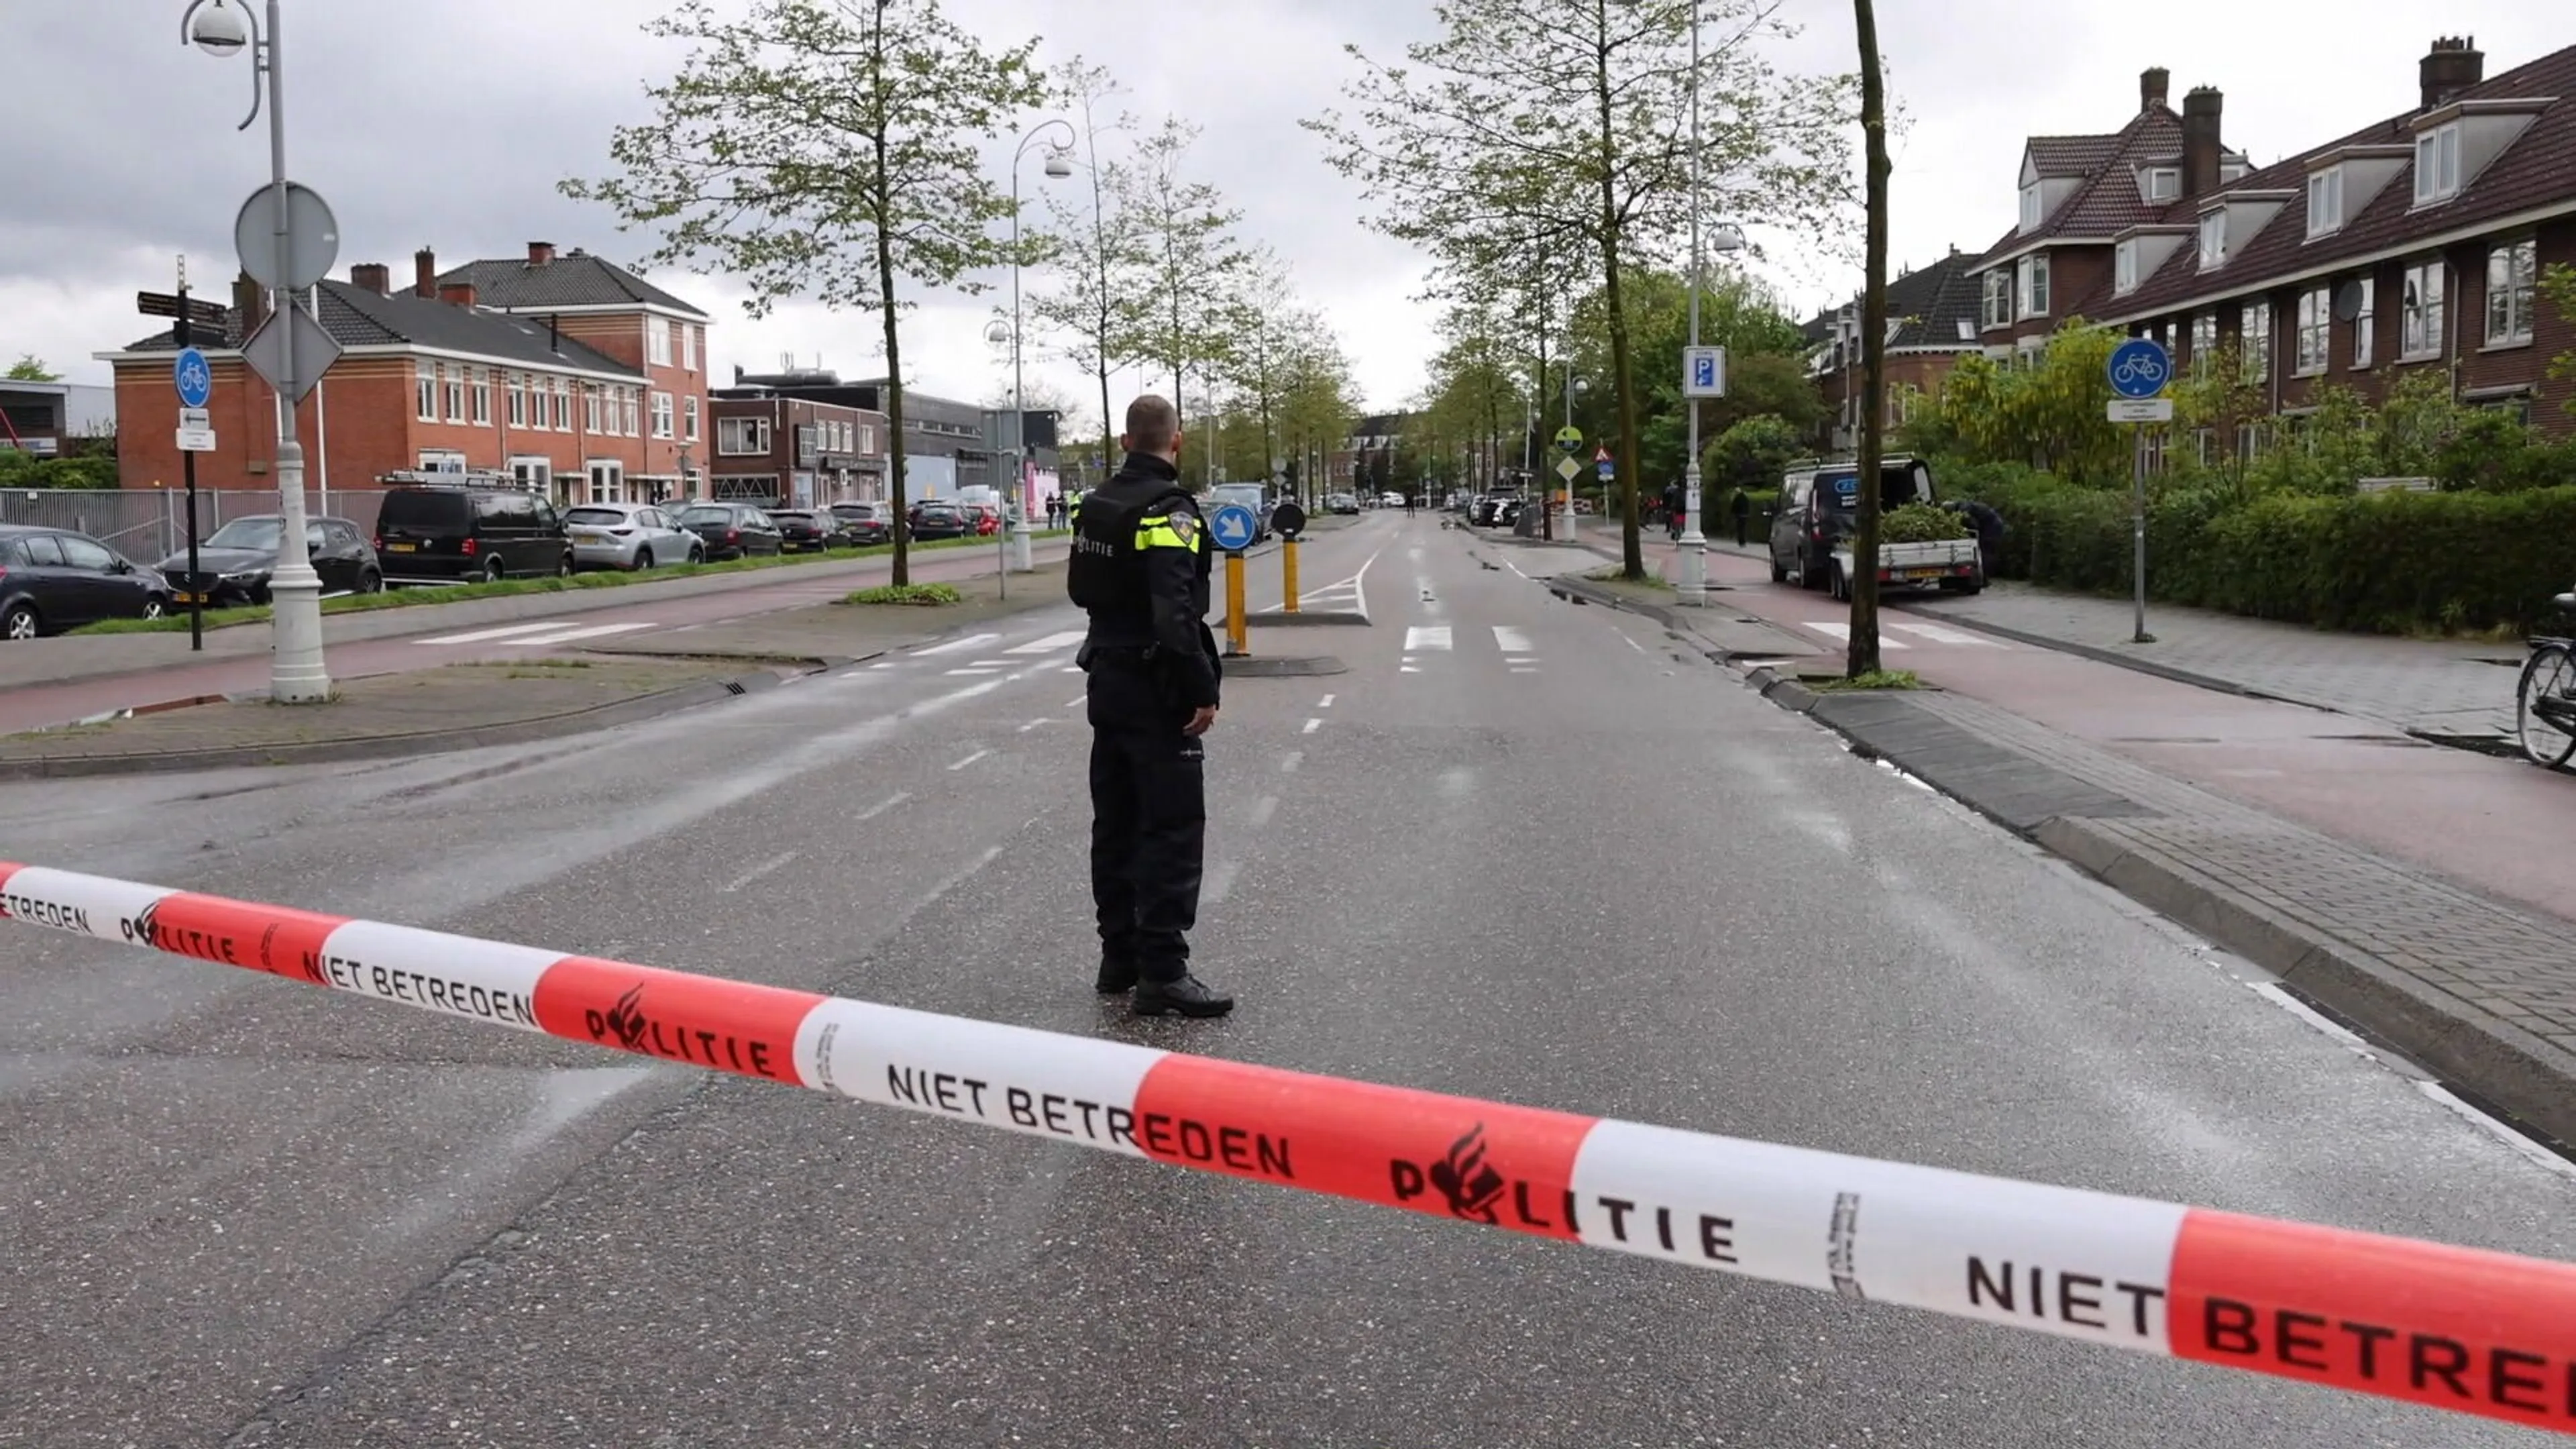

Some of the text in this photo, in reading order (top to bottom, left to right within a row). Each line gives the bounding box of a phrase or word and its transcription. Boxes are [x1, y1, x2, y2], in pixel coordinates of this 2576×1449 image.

[1699, 360, 1710, 375] P
[303, 951, 364, 989] NIET
[372, 966, 537, 1026] BETREDEN
[888, 1064, 987, 1116] NIET
[1007, 1087, 1295, 1179] BETREDEN
[1968, 1256, 2165, 1336] NIET
